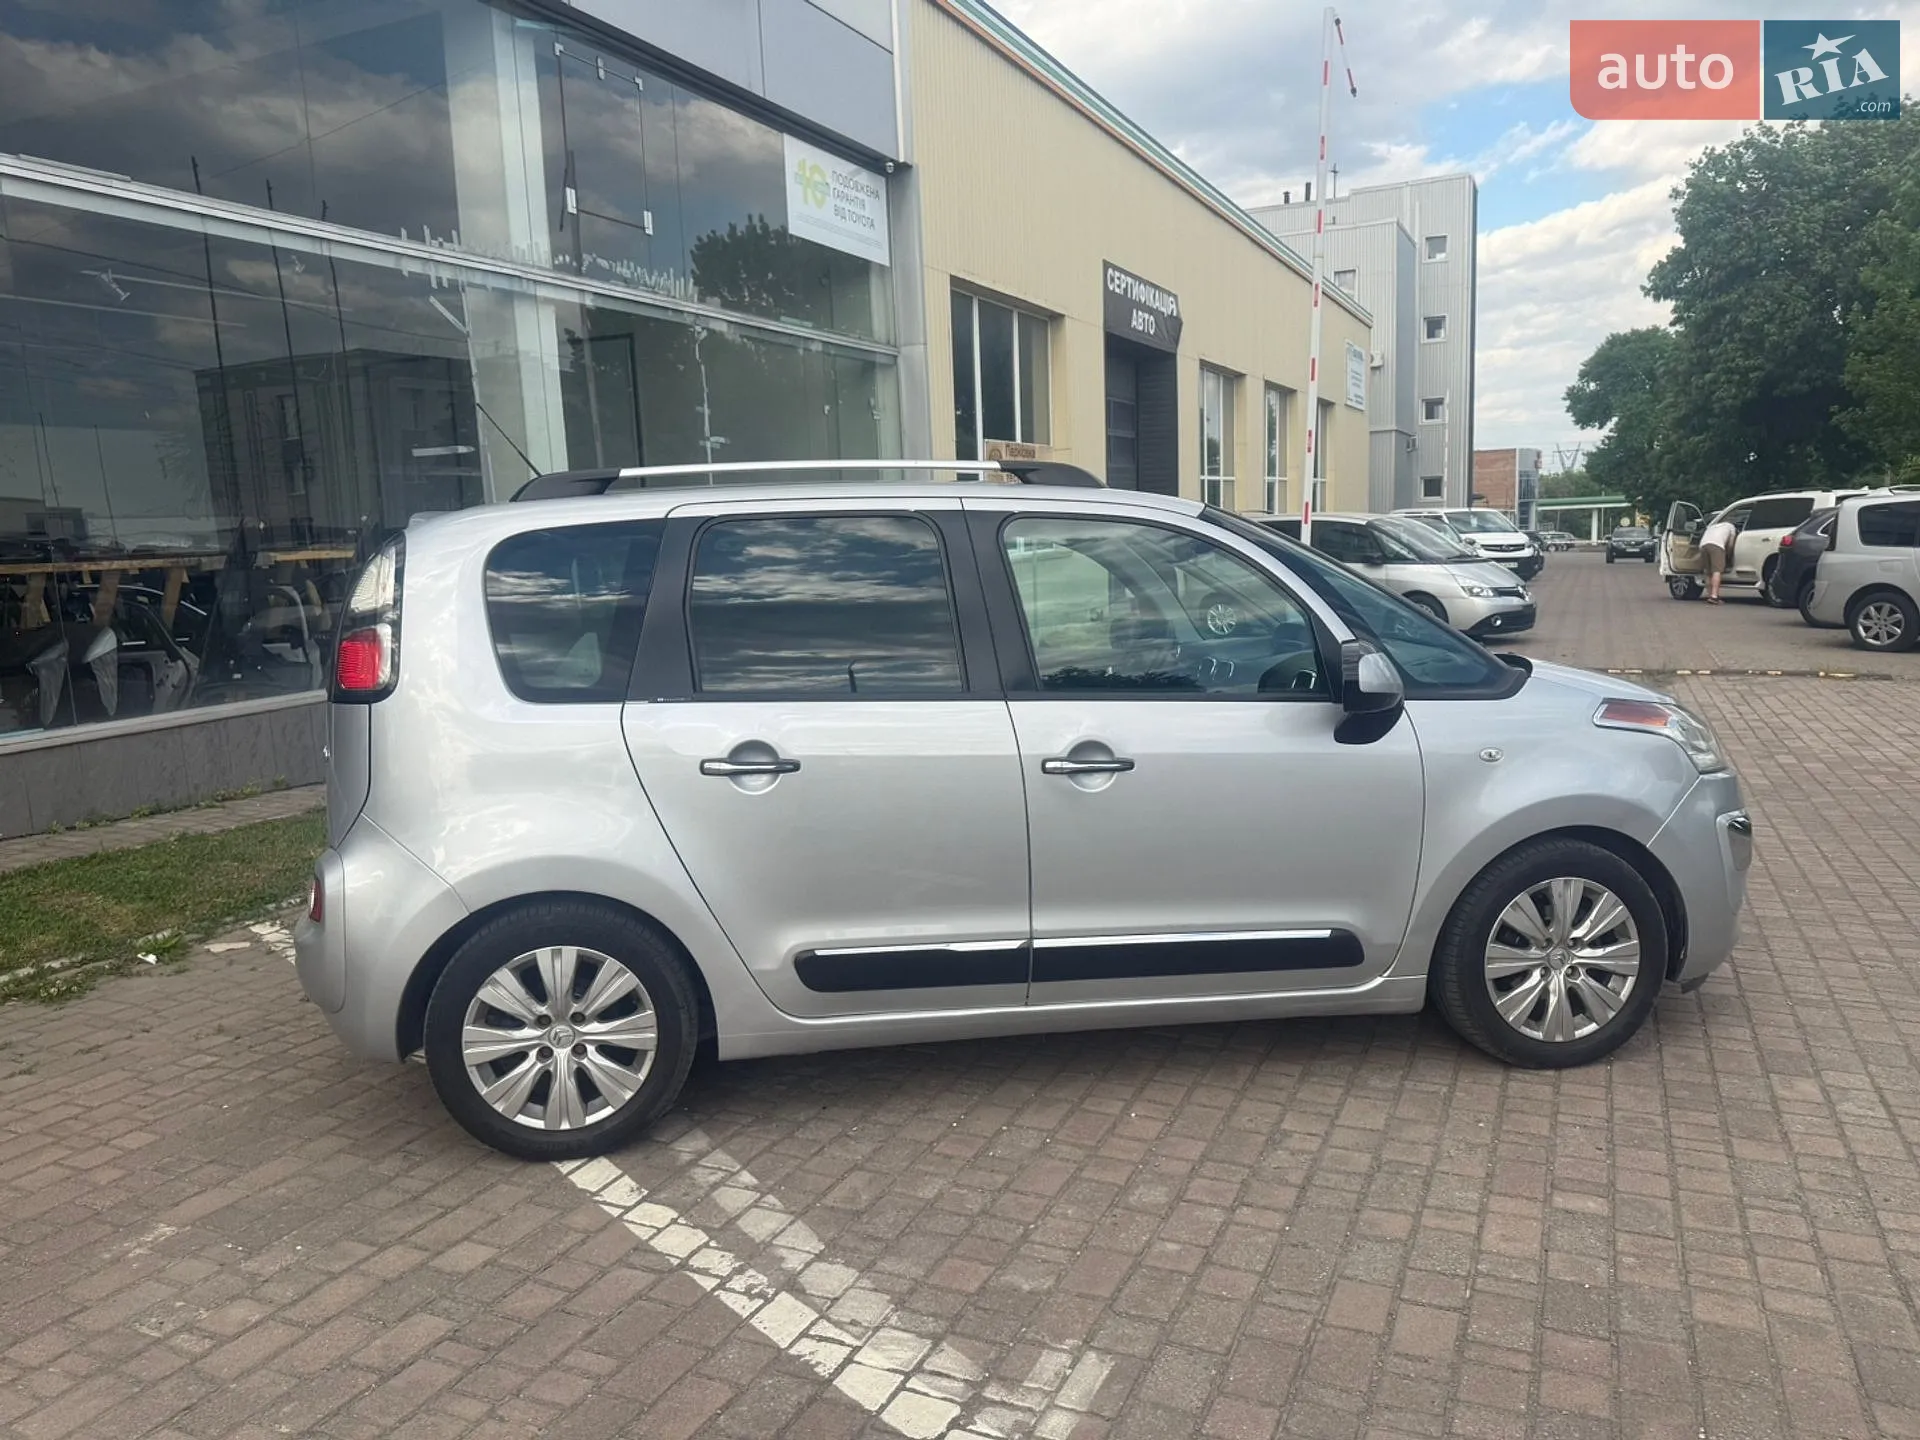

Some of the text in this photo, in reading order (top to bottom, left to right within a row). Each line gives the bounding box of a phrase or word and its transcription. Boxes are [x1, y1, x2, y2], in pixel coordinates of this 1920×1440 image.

[831, 170, 880, 201] ПОДОВЖЕНА
[832, 187, 866, 212] ГАРАНТІЯ
[1106, 267, 1178, 317] СЕРТИФІКАЦІЯ
[1130, 308, 1156, 335] АВТО
